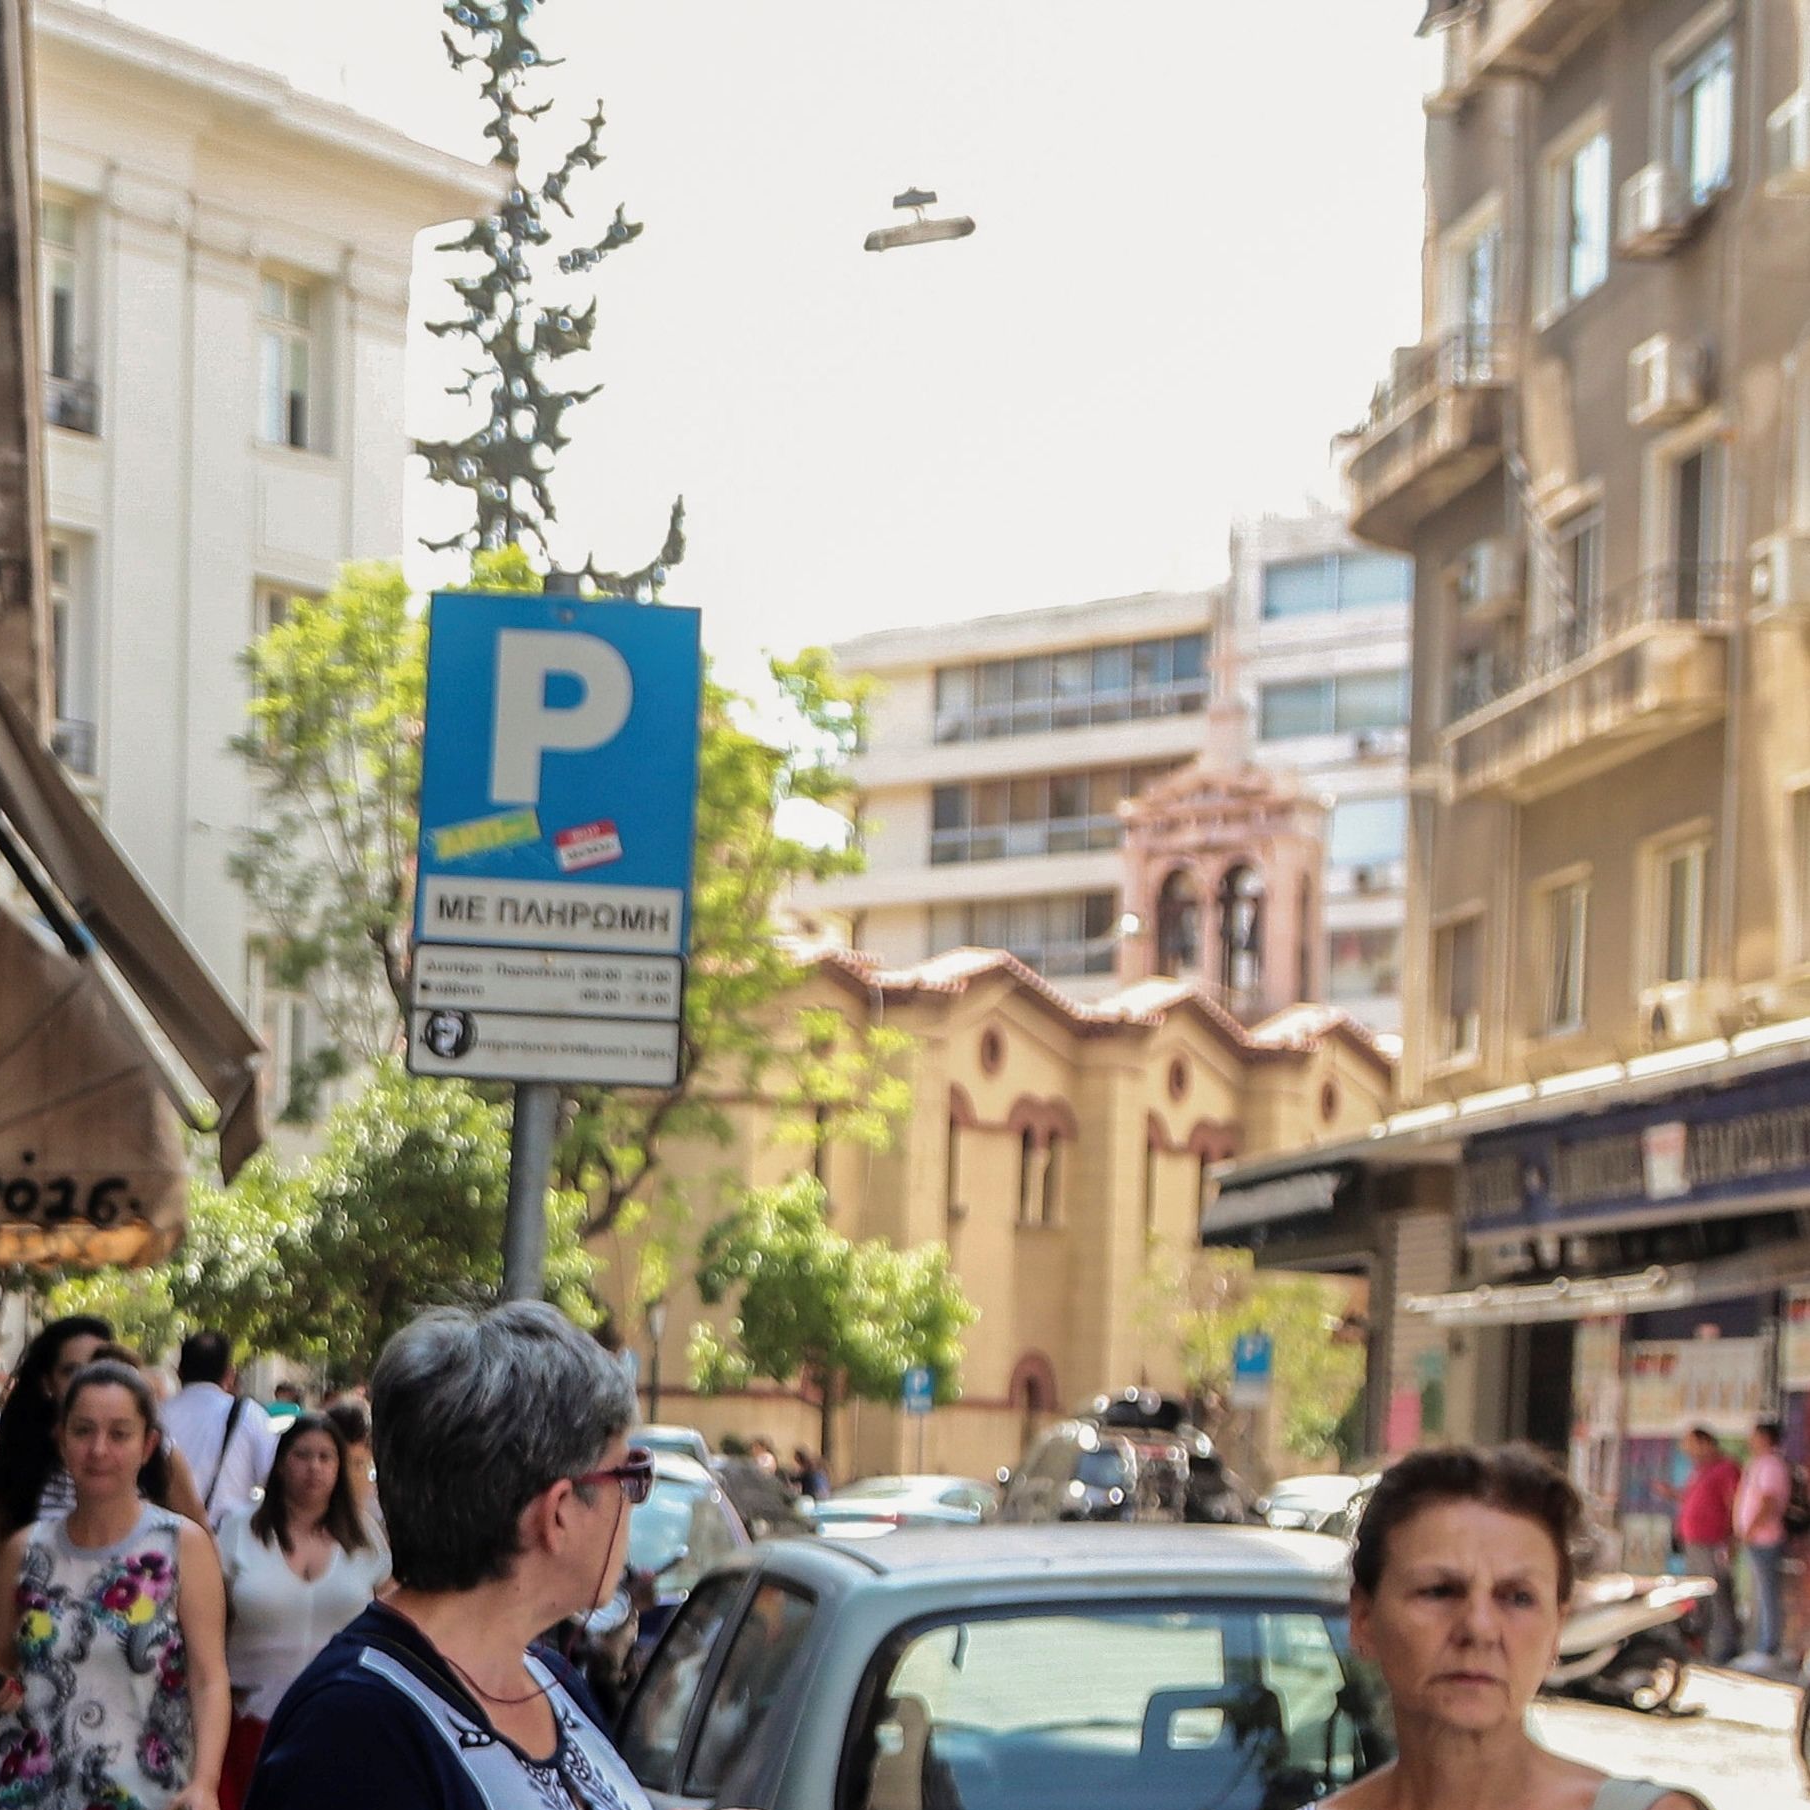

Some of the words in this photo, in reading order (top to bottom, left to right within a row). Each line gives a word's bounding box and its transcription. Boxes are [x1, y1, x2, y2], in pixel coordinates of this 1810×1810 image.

[489, 628, 634, 804] P
[438, 893, 486, 923] ΜΕ
[499, 897, 670, 934] ΠΛΗΡΩΜΗ
